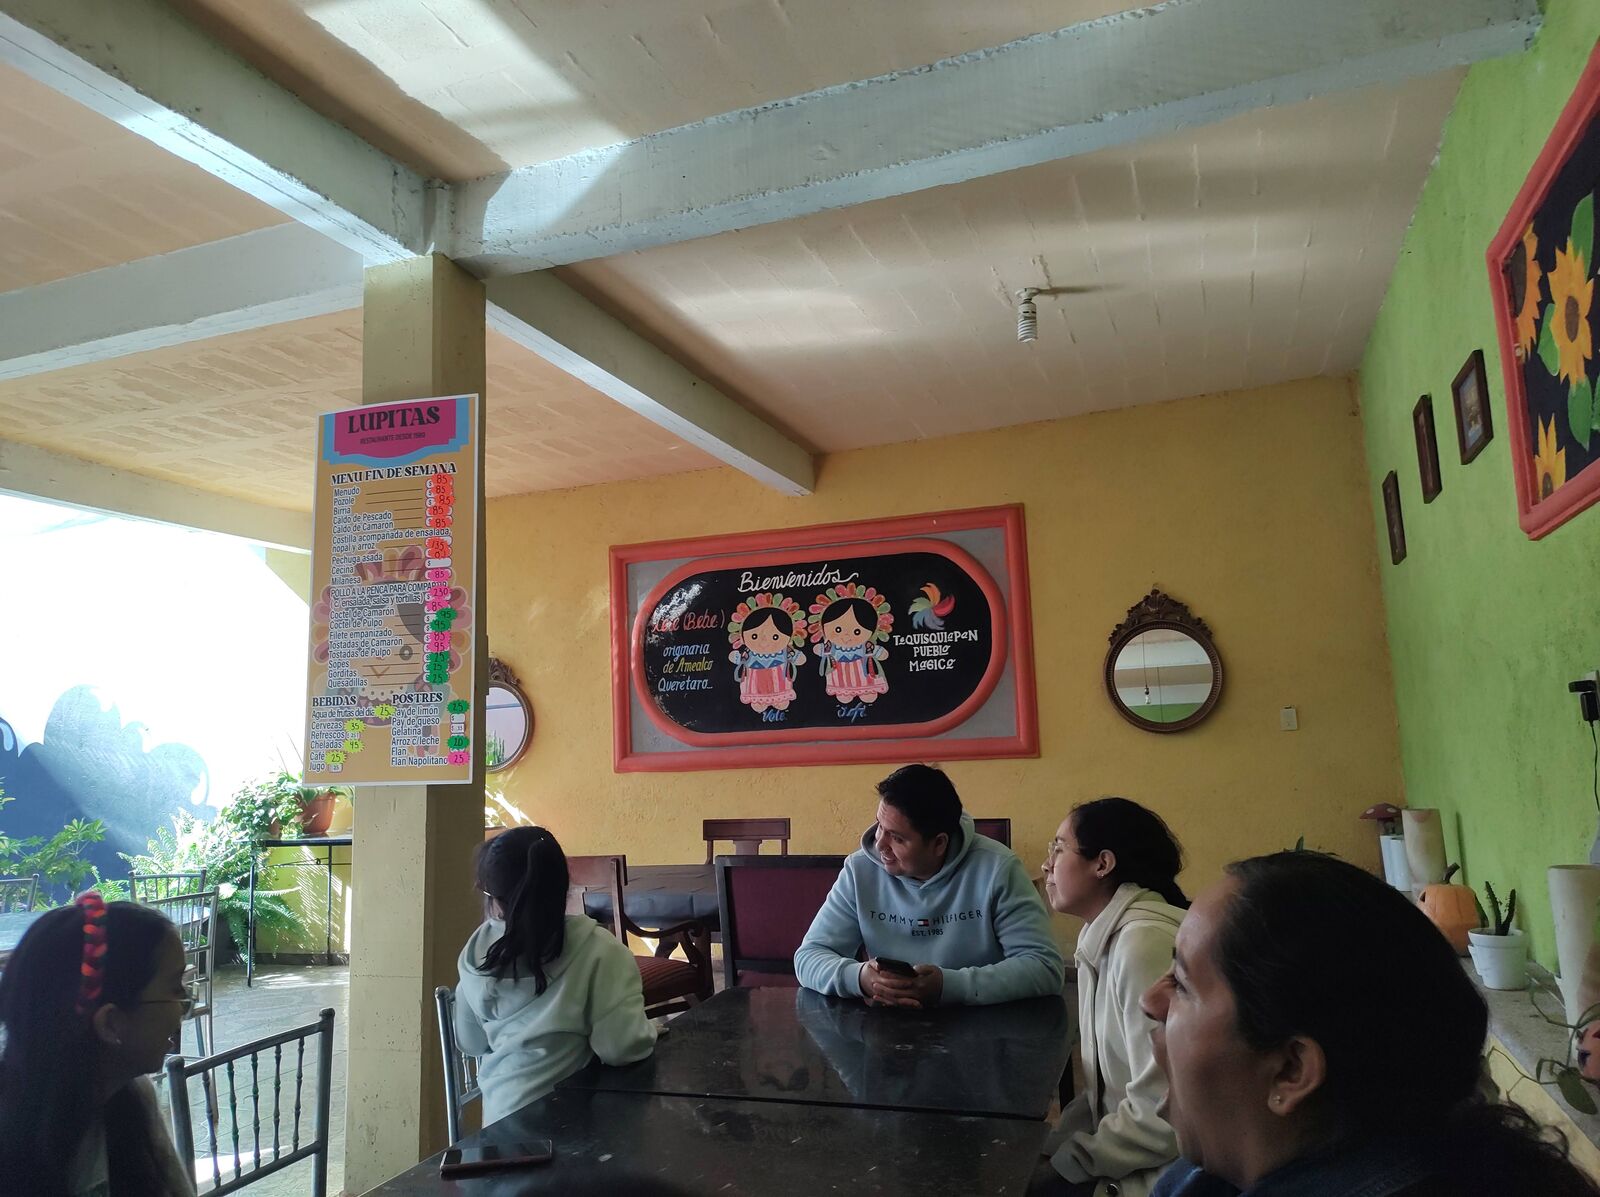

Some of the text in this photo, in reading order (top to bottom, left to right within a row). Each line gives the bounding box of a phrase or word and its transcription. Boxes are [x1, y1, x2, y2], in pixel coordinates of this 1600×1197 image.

[348, 406, 440, 433] LUPITAS
[332, 463, 456, 484] MENU FIN DE SEMANA
[437, 474, 447, 484] 85
[334, 487, 359, 496] Menudo
[436, 485, 445, 494] 85
[334, 497, 354, 506] Pozole
[439, 495, 450, 505] 85
[333, 507, 350, 515] Birria
[432, 506, 444, 515] 85
[333, 512, 391, 524] Caldo de Pescado
[435, 518, 446, 527] 85
[333, 525, 351, 534] Caldo
[353, 524, 360, 532] de
[332, 534, 356, 544] Costilla
[358, 531, 403, 543] acompañada
[405, 529, 414, 537] de
[332, 542, 375, 554] nopal y arroz
[332, 553, 382, 565] Pechuga asada
[332, 565, 353, 574] Cecina
[332, 577, 360, 585] Milanesa
[738, 563, 859, 592] Bienvenidos
[331, 588, 350, 597] POLLO
[358, 586, 365, 595] LA
[367, 584, 388, 594] PENCA
[390, 583, 406, 592] PARA
[373, 595, 388, 604] salsa
[330, 611, 349, 619] Coctel
[353, 609, 360, 617] de
[330, 619, 382, 630] Coctel de Pulpo
[330, 629, 392, 639] Filete empanizado
[329, 640, 358, 649] Tostadas
[361, 639, 368, 647] de
[329, 648, 391, 659] Tostadas de Pulpo
[663, 643, 710, 662] originaria
[328, 661, 349, 669] Sopes
[663, 657, 713, 673] de Amealco
[328, 670, 356, 678] Gorditas
[328, 678, 367, 687] Quesadillas
[312, 696, 356, 707] BEBIDAS
[392, 693, 442, 703] POSTRES
[312, 710, 328, 719] Agua
[329, 709, 336, 717] de
[337, 709, 354, 717] frutas
[355, 708, 364, 717] del
[407, 707, 415, 715] de
[418, 705, 438, 715] limón
[311, 721, 342, 730] Cervezas
[392, 717, 439, 728] Pay de queso
[311, 731, 345, 740] Refrescos
[392, 727, 421, 736] Gelatina
[310, 741, 342, 749] Cheladas
[392, 738, 410, 746] Arroz
[310, 751, 325, 761] Café
[392, 747, 406, 755] Flan
[332, 754, 340, 762] 25
[392, 756, 447, 766] Flan Napolitano
[455, 755, 464, 763] 25
[309, 763, 325, 772] Jugo
[870, 909, 983, 926] TOMMY HILFIGER
